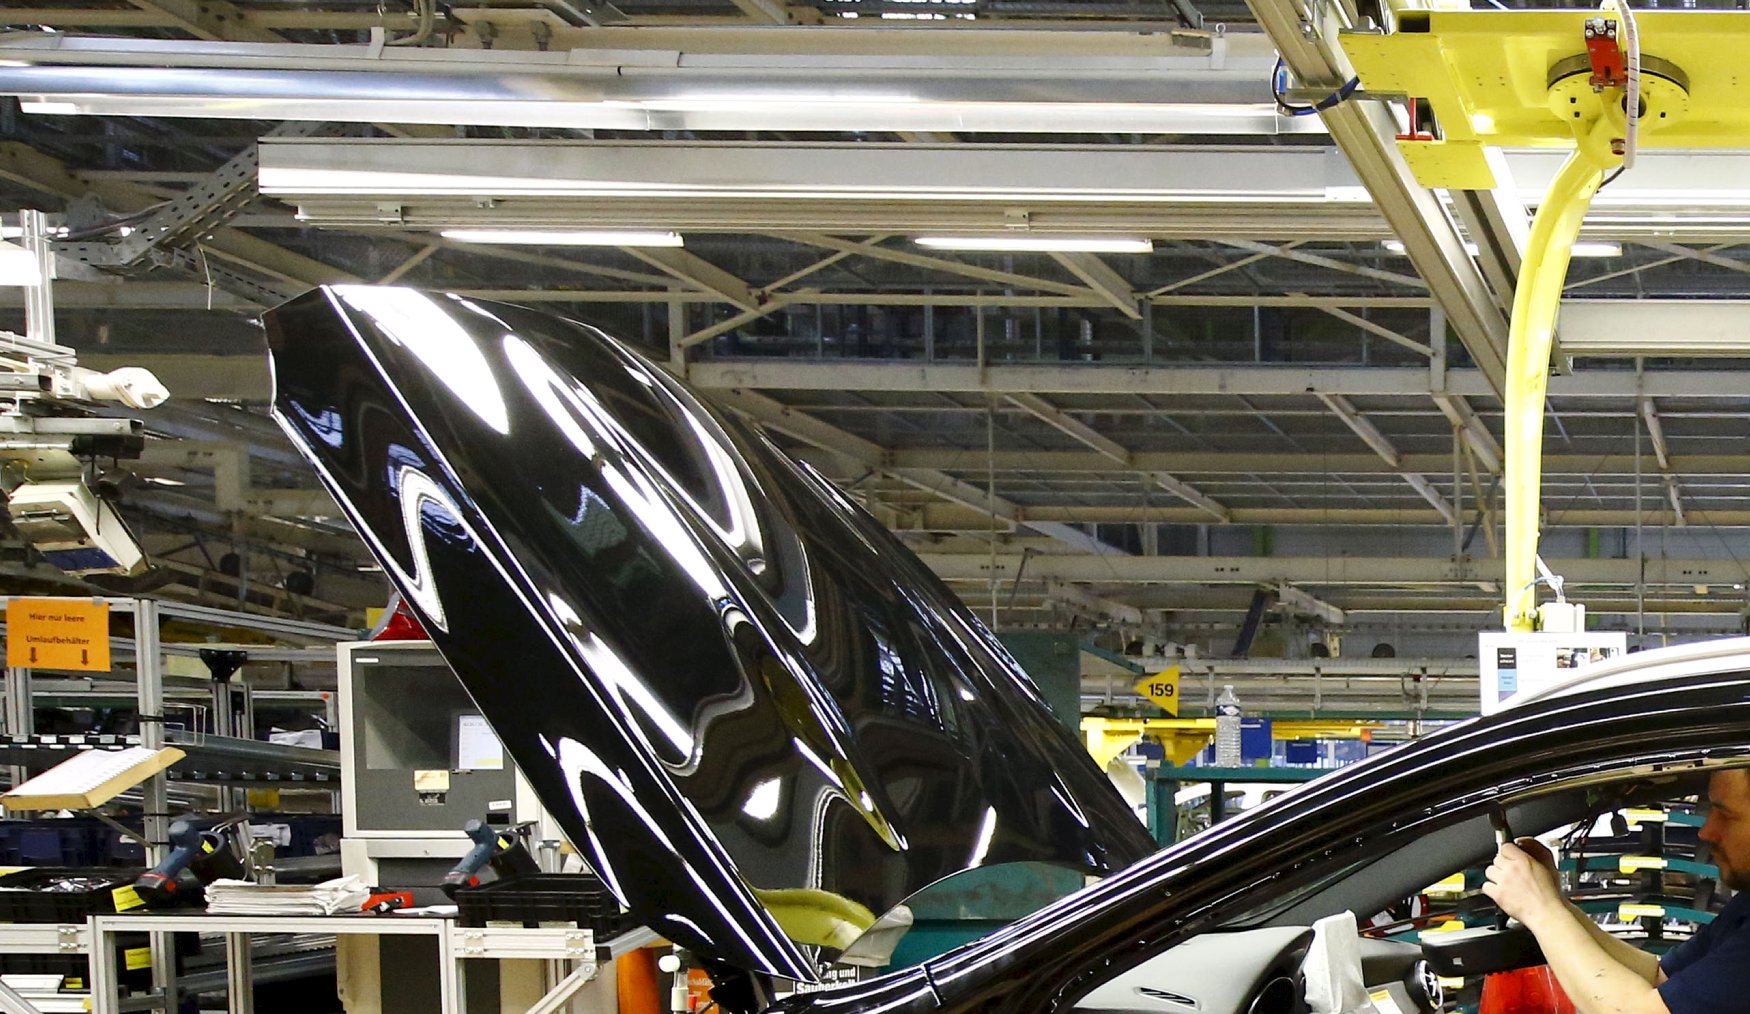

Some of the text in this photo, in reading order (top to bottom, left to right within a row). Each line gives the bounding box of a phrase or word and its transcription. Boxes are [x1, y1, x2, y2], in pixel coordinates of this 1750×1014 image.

[29, 613, 46, 621] Hier
[48, 613, 63, 622] nur
[1148, 683, 1174, 697] 159
[839, 967, 856, 978] und
